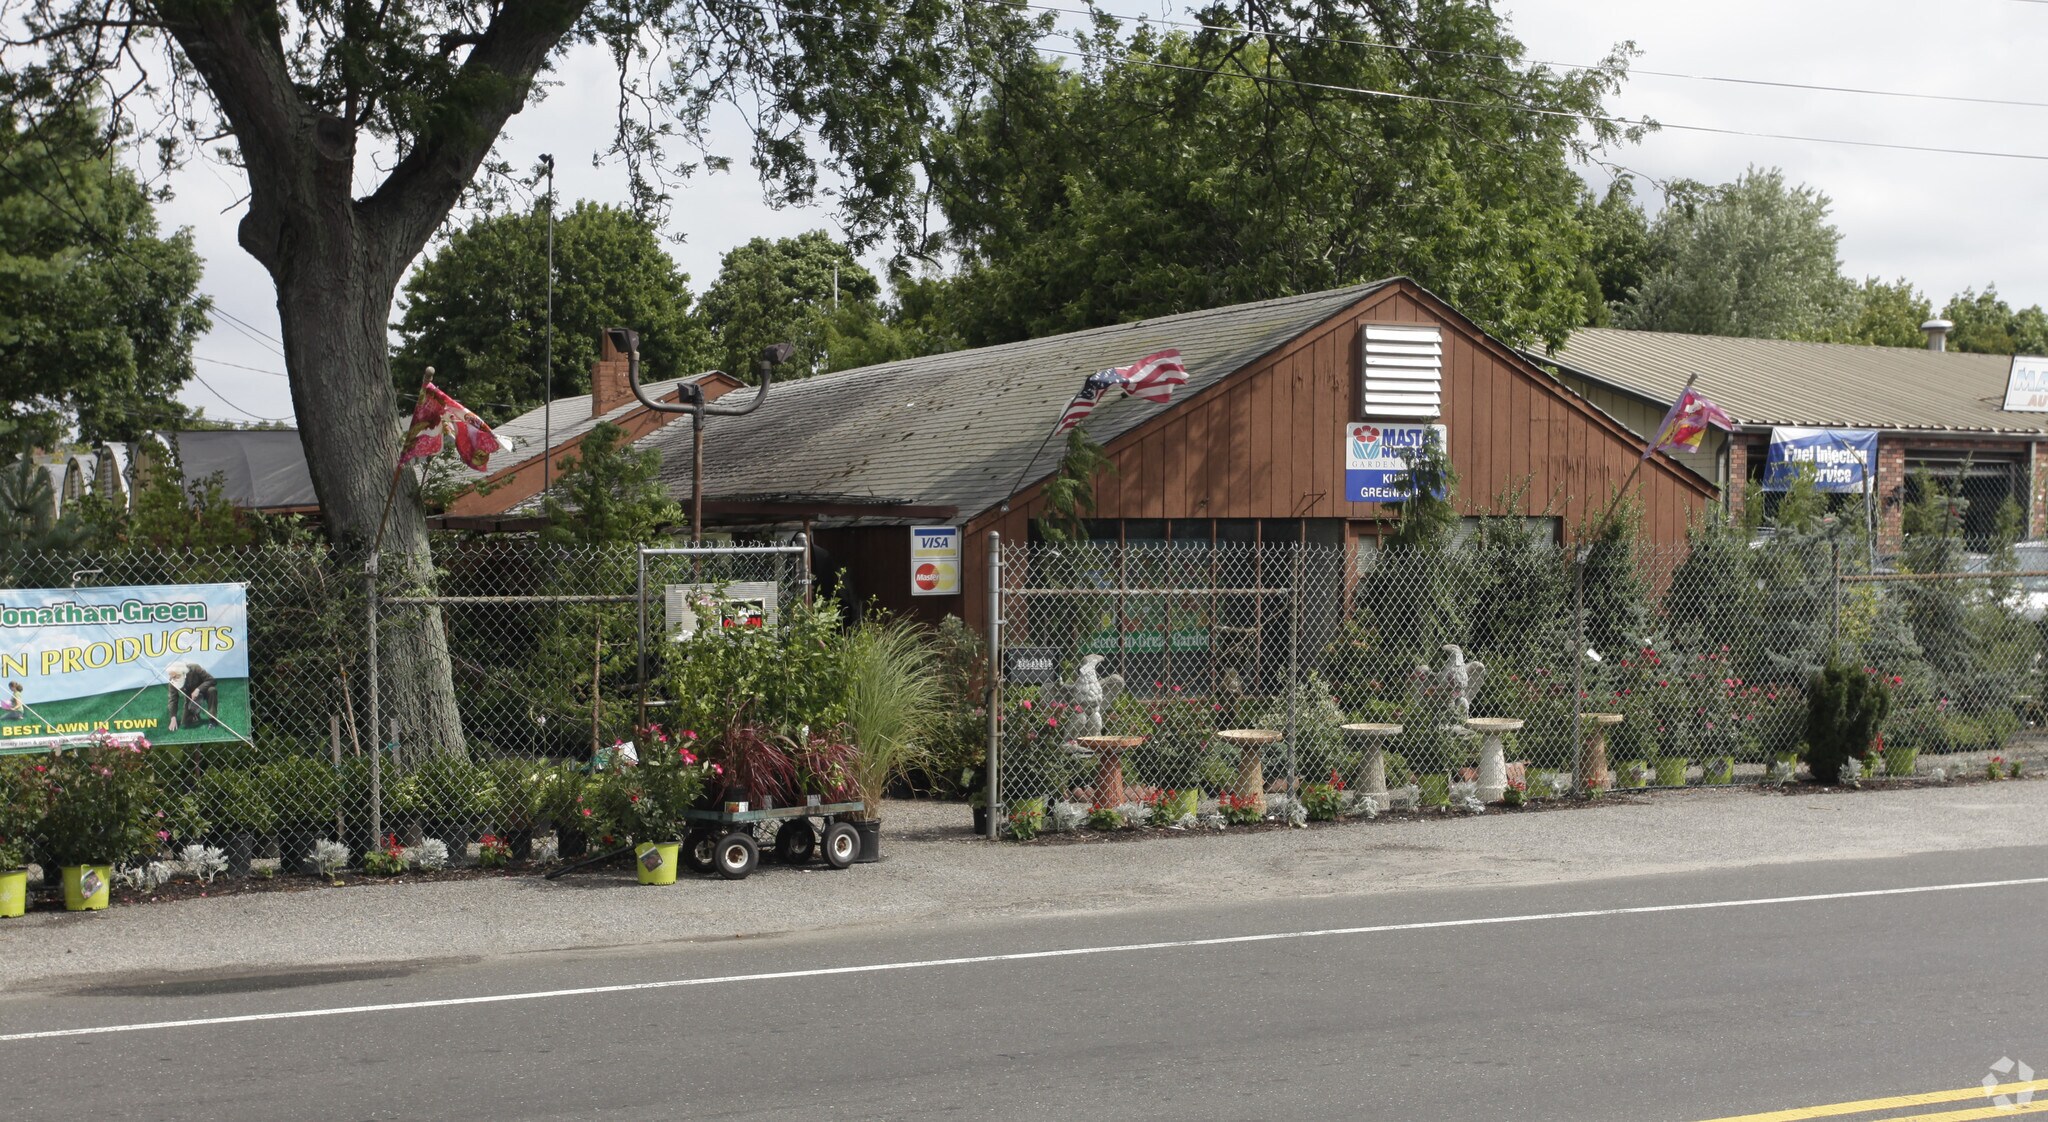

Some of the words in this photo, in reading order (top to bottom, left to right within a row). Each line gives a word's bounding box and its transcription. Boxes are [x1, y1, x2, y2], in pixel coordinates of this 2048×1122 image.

[1382, 428, 1440, 446] MAST
[1784, 444, 1814, 462] Fuel
[1352, 460, 1396, 468] GARDEN
[1803, 465, 1852, 483] ervice
[921, 537, 949, 548] VISA
[121, 599, 207, 624] Green
[41, 626, 234, 676] PRODUCTS
[2, 725, 41, 736] BEST
[46, 722, 88, 734] LAWN
[93, 721, 109, 731] IN
[114, 719, 157, 730] TOWN
